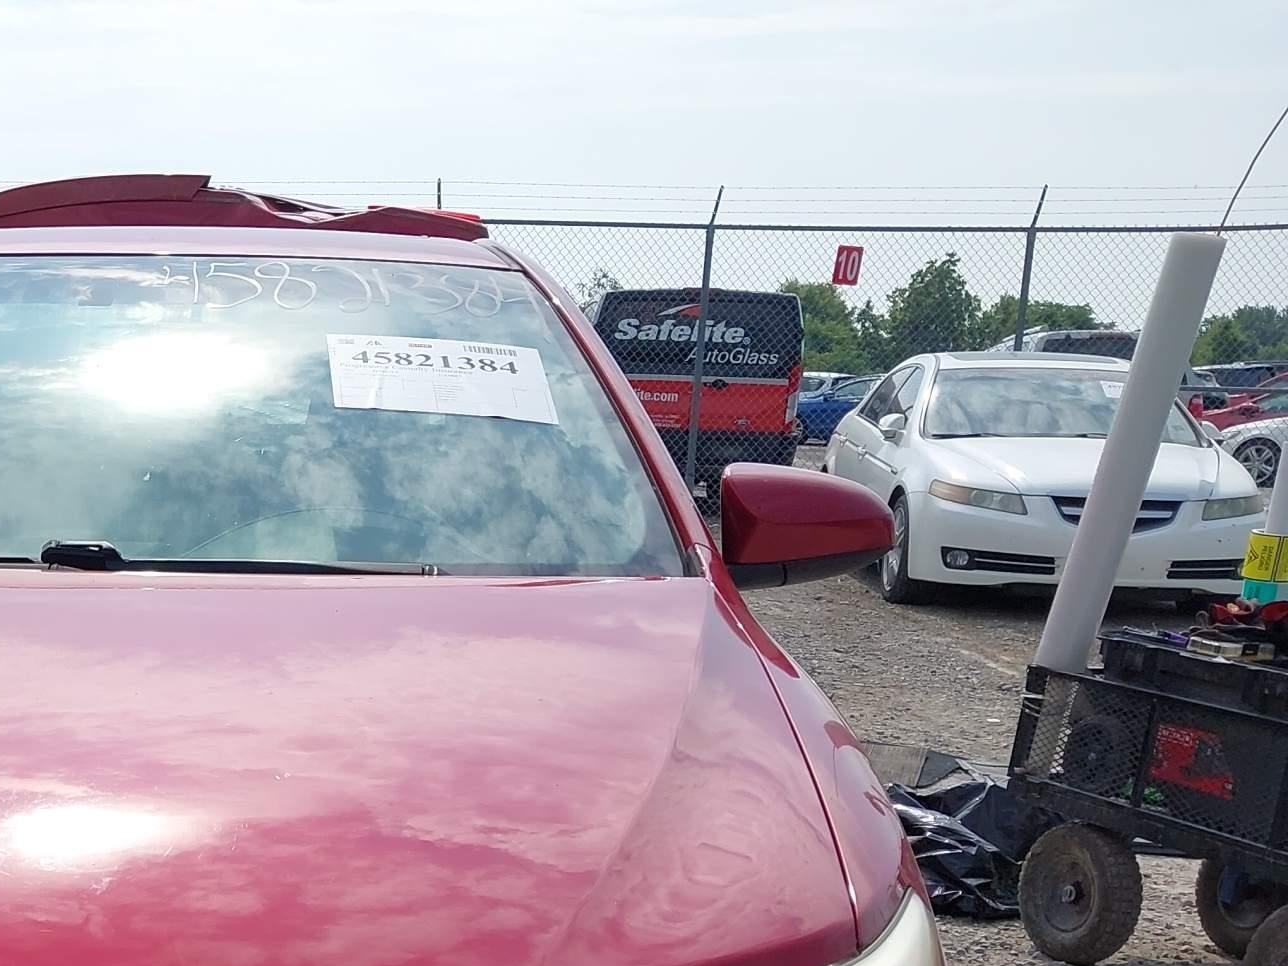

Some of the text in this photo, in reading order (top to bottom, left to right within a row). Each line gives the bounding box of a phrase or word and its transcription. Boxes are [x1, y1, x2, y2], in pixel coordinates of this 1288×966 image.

[837, 250, 860, 282] 10
[614, 318, 746, 344] Safelite
[351, 349, 519, 375] 45821384
[634, 388, 679, 402] ite.com
